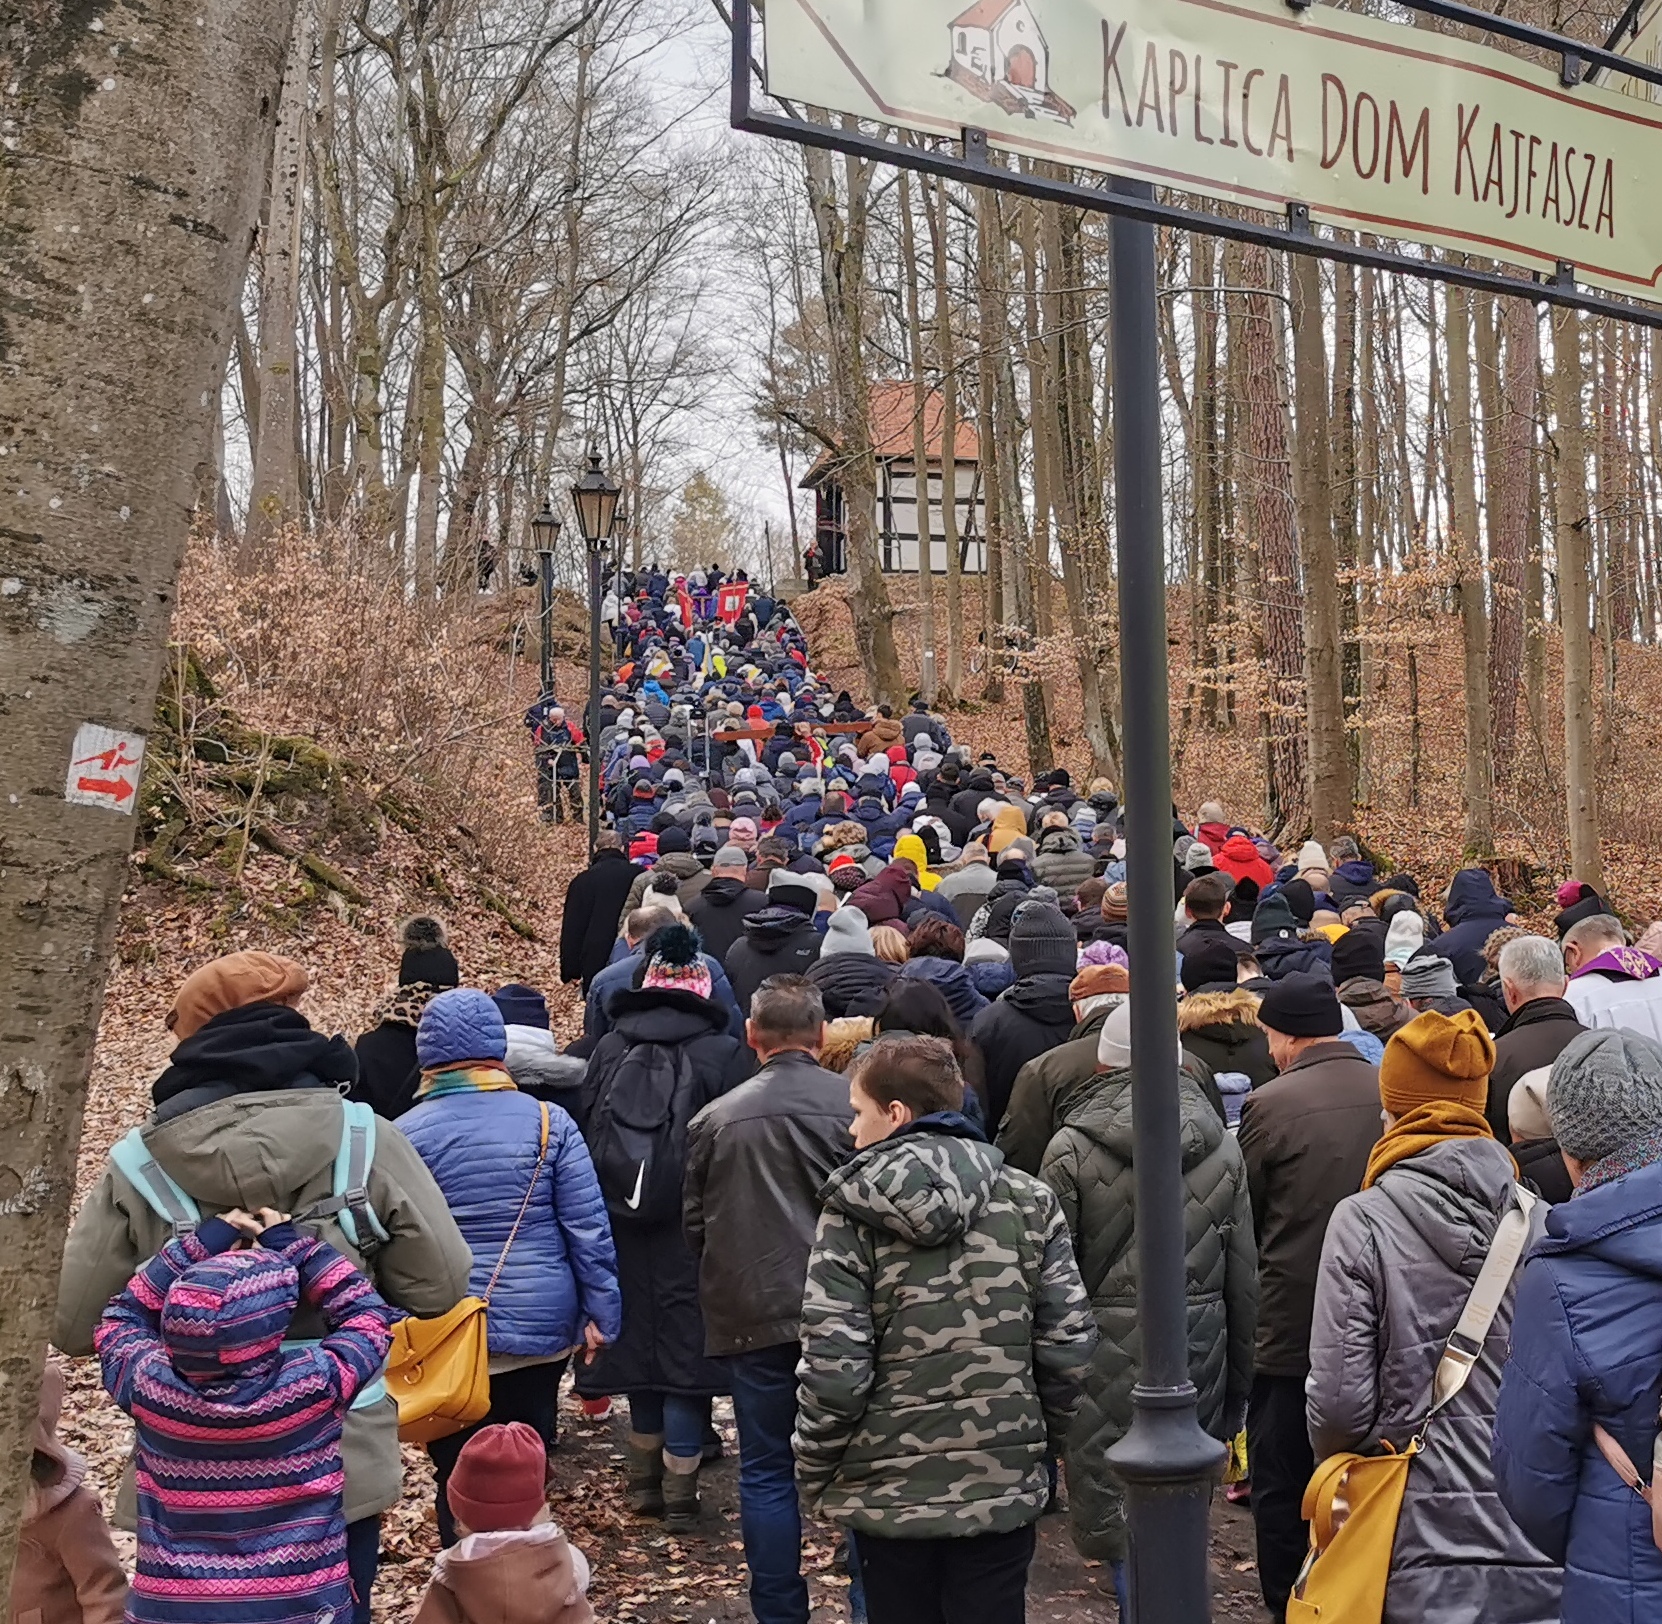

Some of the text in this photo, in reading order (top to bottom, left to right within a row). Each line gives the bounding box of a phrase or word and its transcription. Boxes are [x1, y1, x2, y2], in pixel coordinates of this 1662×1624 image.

[1101, 18, 1616, 240] KAPLICA DOM KAJFASZA
